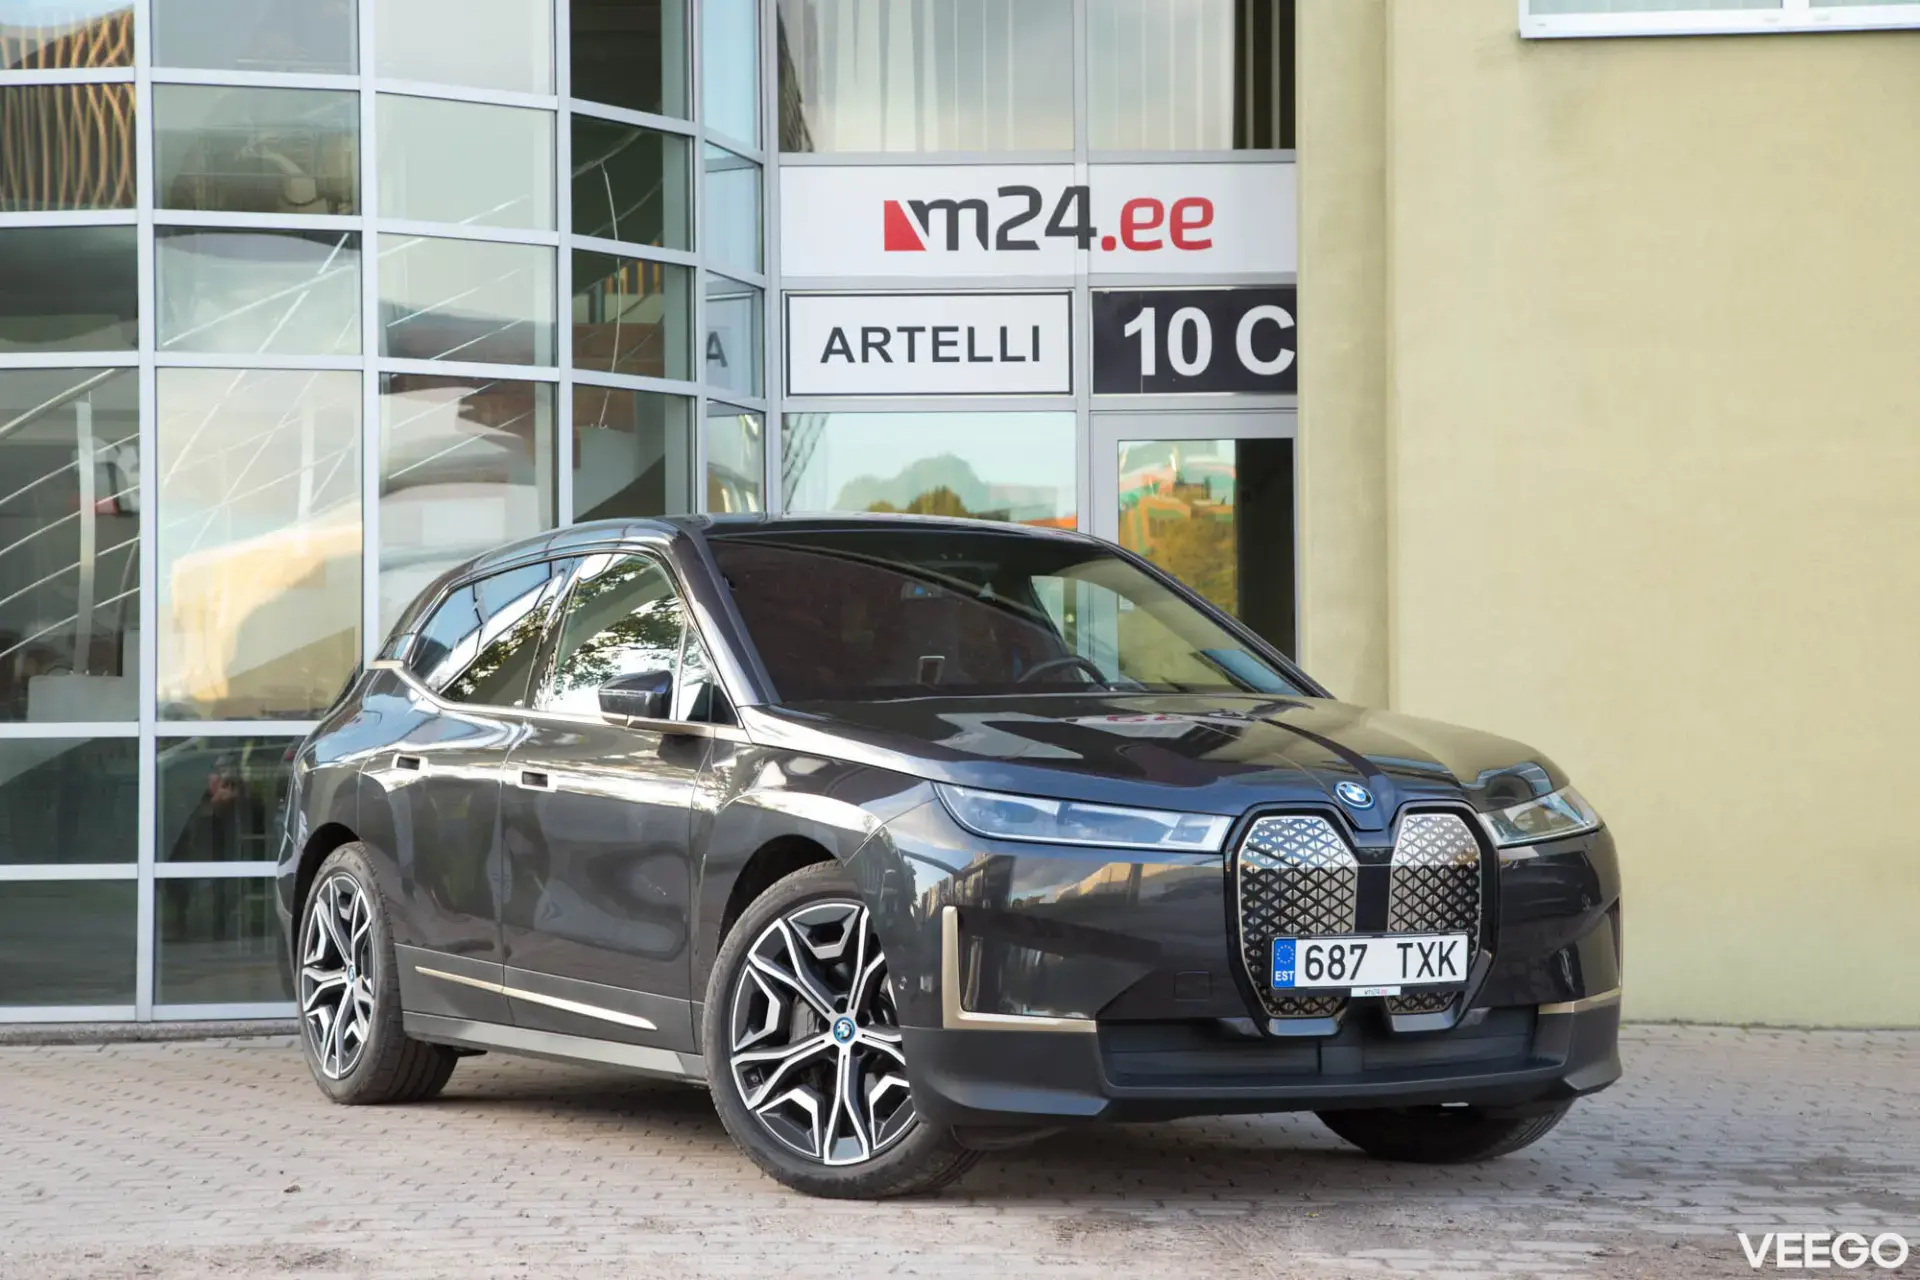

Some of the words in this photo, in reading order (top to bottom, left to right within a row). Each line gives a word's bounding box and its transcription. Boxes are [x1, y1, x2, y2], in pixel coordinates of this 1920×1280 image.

[906, 185, 1214, 252] m24.ee
[820, 325, 1040, 364] ARTELLI
[1123, 306, 1213, 377] 10
[1235, 305, 1295, 376] C
[1275, 970, 1294, 981] EST
[1305, 943, 1368, 981] 687
[1397, 940, 1458, 978] TXK
